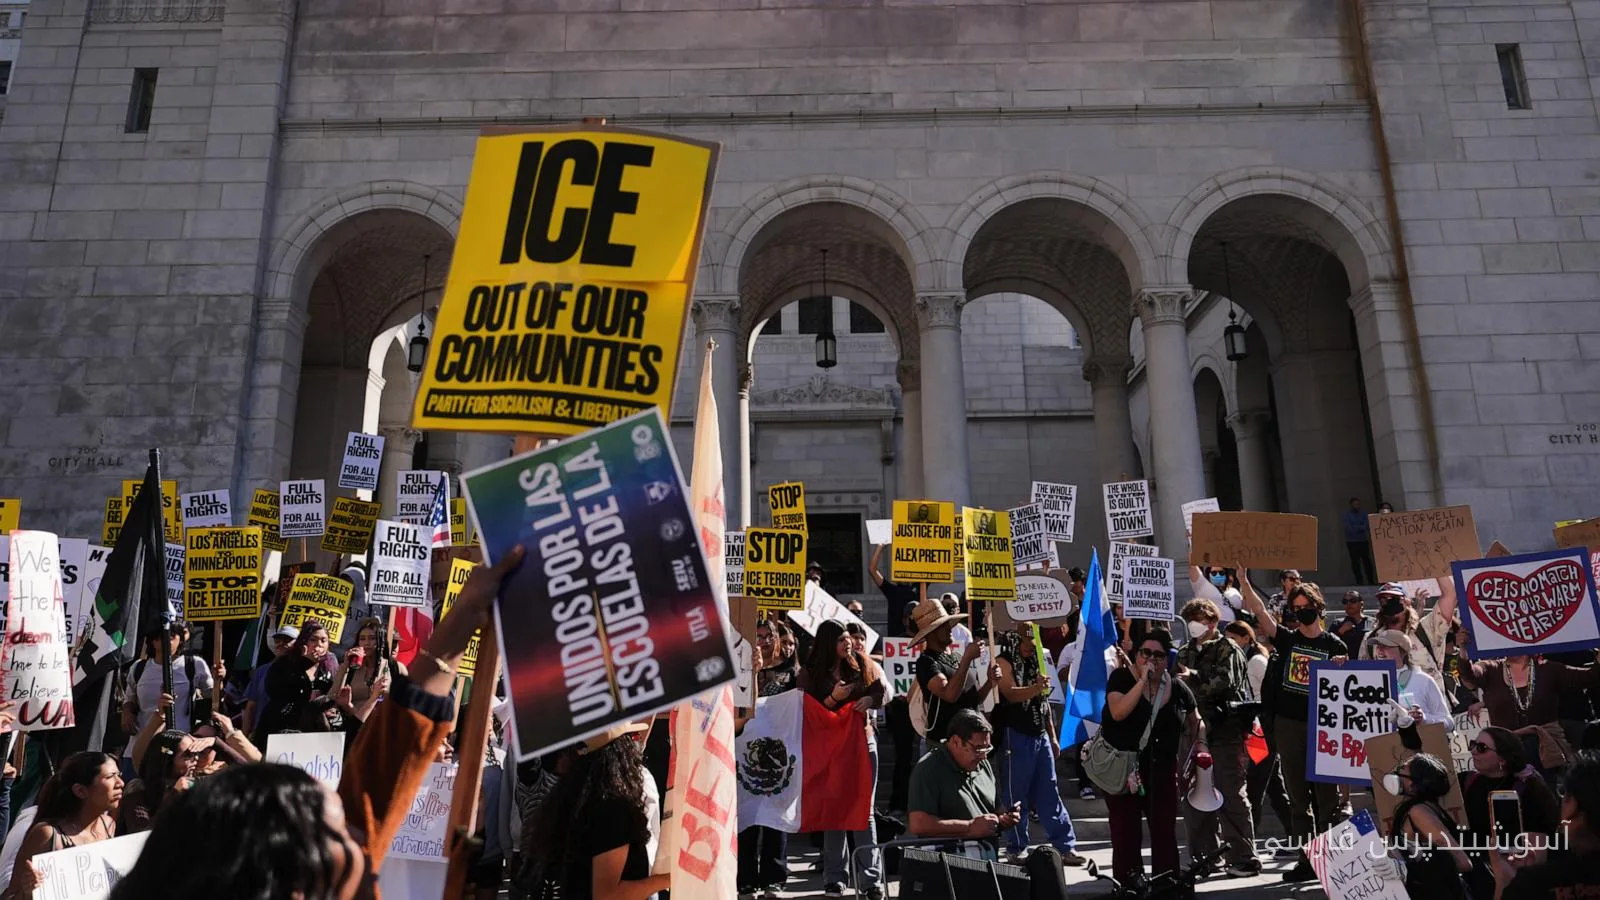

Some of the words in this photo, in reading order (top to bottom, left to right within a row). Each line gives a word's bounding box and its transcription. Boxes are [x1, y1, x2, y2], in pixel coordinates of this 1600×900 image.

[500, 139, 655, 267] ICE
[463, 282, 527, 332] OUT
[525, 281, 574, 330] OF
[572, 285, 649, 339] OUR
[434, 333, 663, 396] COMMUNITIES
[427, 394, 468, 412] PARTY
[466, 395, 490, 414] FOR
[489, 395, 551, 416] SOCIALISM
[554, 399, 572, 417] &
[573, 400, 645, 422] LIBERATI
[1575, 423, 1596, 431] 200
[353, 436, 375, 448] FULL
[1549, 434, 1581, 444] CITY
[347, 446, 380, 459] RIGHTS
[48, 457, 80, 467] CITY
[87, 457, 124, 466] HALL
[343, 464, 359, 474] FOR
[361, 466, 375, 476] ALL
[405, 473, 431, 484] FULL
[288, 483, 315, 494] FULL
[400, 485, 438, 495] RIGHTS
[1036, 483, 1049, 493] THE
[1049, 485, 1072, 496] WHOLE
[1107, 483, 1120, 494] THE
[1120, 481, 1144, 493] WHOLE
[189, 493, 220, 507] FULL
[255, 493, 268, 504] LOS
[283, 493, 322, 505] RIGHTS
[519, 462, 571, 532] LAS
[770, 485, 801, 510] STOP
[1035, 493, 1073, 501] SYSTEM
[1109, 500, 1117, 511] IS
[1118, 498, 1145, 510] GUILTY
[185, 503, 228, 518] RIGHTS
[335, 501, 349, 512] LOS
[349, 504, 378, 516] ANGELES
[400, 503, 417, 512] FOR
[420, 503, 431, 512] AL
[1016, 505, 1039, 519] WHOLE
[1044, 499, 1071, 512] GUILTY
[283, 513, 302, 523] FOR
[304, 512, 322, 521] ALL
[578, 496, 626, 548] DE
[773, 514, 782, 525] ICE
[781, 513, 803, 524] TERROR
[1010, 514, 1041, 525] YSTEM
[1112, 515, 1146, 531] DOWN!
[1379, 515, 1408, 528] MAKE
[327, 526, 369, 537] STOP
[387, 526, 420, 545] FULL
[895, 524, 931, 538] JUSTICE
[933, 525, 951, 539] FOR
[1014, 520, 1040, 537] GUILTY
[1374, 525, 1424, 540] FICTION
[1430, 517, 1464, 533] AGAIN
[190, 535, 210, 550] LOS
[212, 534, 258, 549] ANGELES
[749, 531, 803, 564] STOP
[966, 534, 994, 551] JUSTICE
[993, 537, 1009, 552] FOR
[379, 541, 428, 560] RIGHTS
[895, 548, 918, 562] ALEX
[919, 549, 951, 564] PRETTI
[1114, 543, 1128, 554] THE
[1128, 544, 1154, 557] WHOLE
[189, 555, 258, 571] MINNEAPOLIS
[540, 528, 589, 600] POR
[967, 562, 985, 577] ALEX
[985, 563, 1012, 579] PRETTI
[1113, 559, 1121, 571] IS
[1141, 559, 1170, 569] PUEBLO
[376, 570, 400, 583] FOR
[402, 572, 423, 586] ALL
[671, 559, 692, 592] SEIU
[746, 572, 762, 586] ICE
[764, 572, 801, 587] TERROR
[1131, 567, 1166, 580] UNIDO
[188, 576, 258, 590] STOP
[296, 577, 313, 587] LOS
[313, 579, 350, 596] ANGELES
[373, 583, 424, 596] IMMIGRANTS
[1028, 582, 1049, 590] NEVER
[1474, 577, 1503, 600] ICE
[1520, 576, 1537, 596] NO
[13, 579, 48, 612] the
[188, 590, 208, 608] ICE
[210, 589, 257, 607] TERROR
[291, 591, 346, 609] MINNEAPOLIS
[746, 587, 801, 599] NOW!
[1038, 591, 1059, 600] JUST
[1131, 590, 1143, 599] LAS
[1144, 590, 1172, 601] FAMILIAS
[287, 604, 343, 619] STOP
[1014, 605, 1025, 613] TO
[1028, 600, 1064, 612] EXIST!
[1128, 599, 1170, 610] INMIGRANTES
[1478, 599, 1520, 627] FOR
[1519, 594, 1543, 616] OUR
[1541, 582, 1581, 609] WARM
[283, 613, 300, 625] ICE
[590, 542, 665, 708] ESCUELAS
[685, 606, 709, 643] UTLA
[1505, 607, 1564, 641] HEARTS
[11, 616, 52, 645] dream
[10, 649, 32, 671] have
[38, 654, 47, 670] to
[551, 591, 616, 726] UNIDOS
[11, 676, 60, 700] believe
[1318, 677, 1340, 702] Be
[1343, 673, 1390, 704] Good
[1317, 704, 1338, 729] Be
[1342, 704, 1390, 734] Pretti
[1317, 730, 1339, 756] Be
